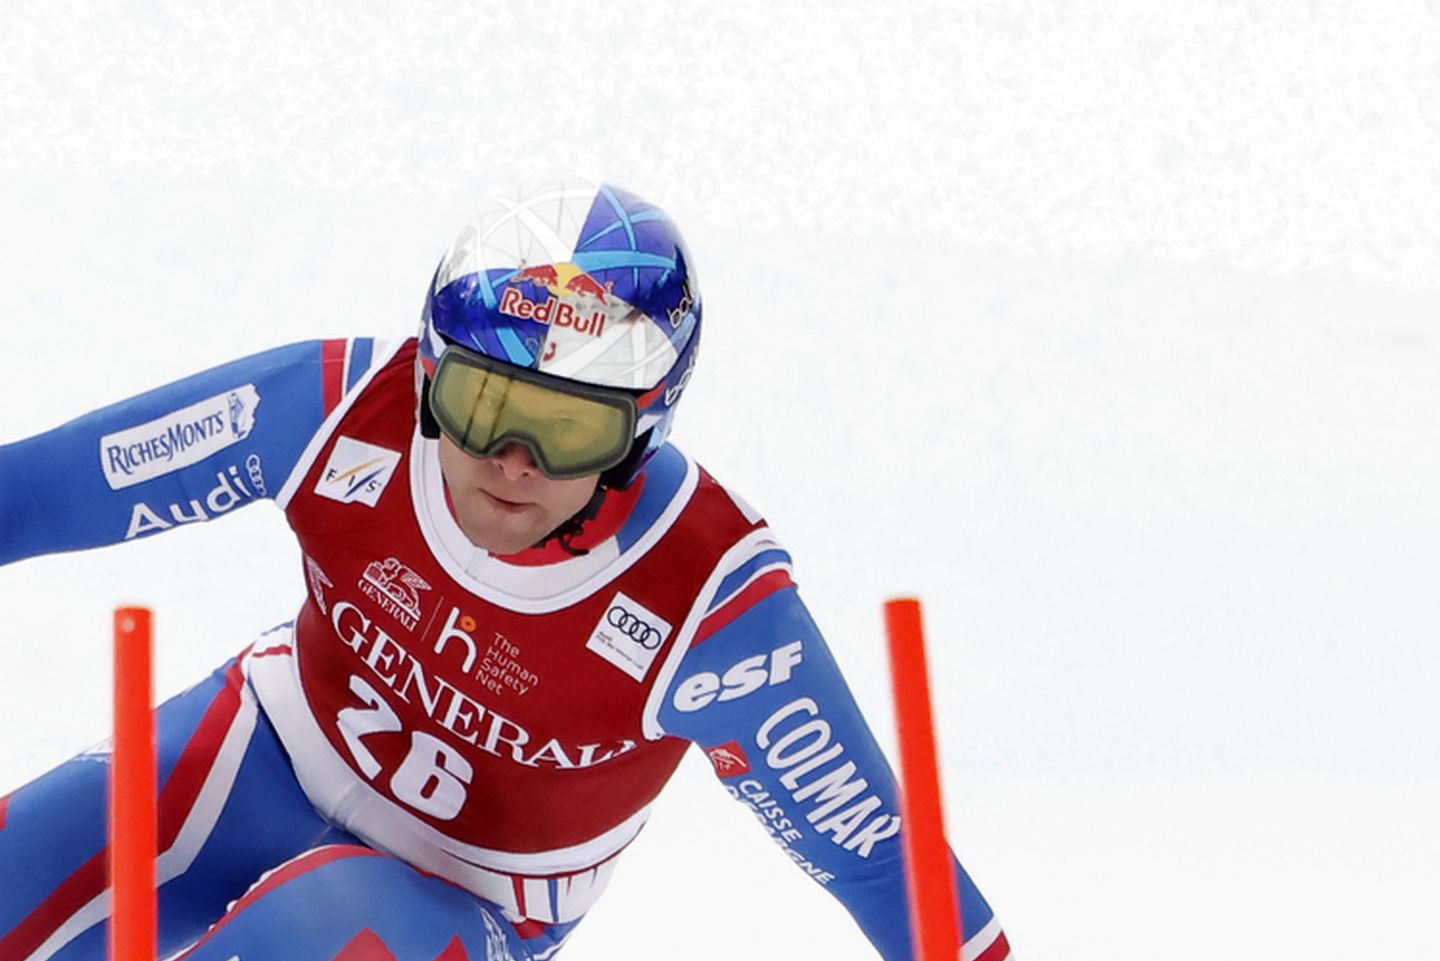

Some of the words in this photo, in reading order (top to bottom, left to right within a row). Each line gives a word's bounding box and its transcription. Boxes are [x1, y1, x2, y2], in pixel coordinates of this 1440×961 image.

[500, 287, 555, 325] Red
[554, 302, 605, 338] Bull
[125, 465, 252, 540] Audi
[357, 579, 417, 632] GENERALI
[486, 646, 539, 686] Human
[493, 631, 520, 658] The
[475, 669, 503, 696] Net
[481, 657, 529, 696] Safety
[336, 675, 474, 821] 26
[755, 697, 902, 858] COLMAR
[739, 779, 803, 842] CAISSE
